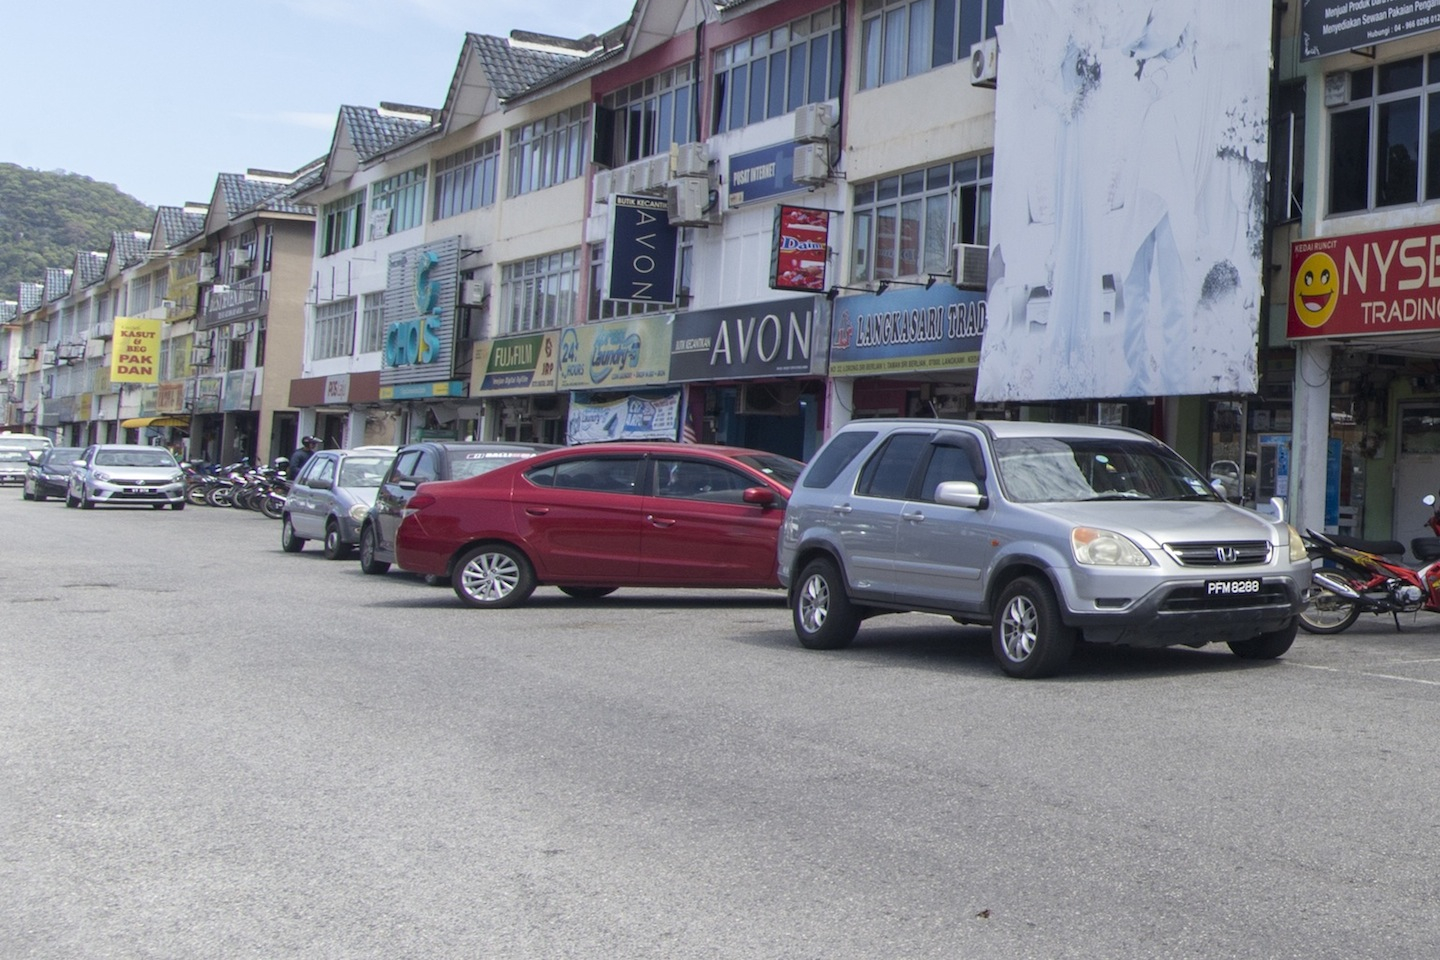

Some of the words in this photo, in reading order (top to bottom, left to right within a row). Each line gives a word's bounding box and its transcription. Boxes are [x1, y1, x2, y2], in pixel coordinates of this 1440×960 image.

[1325, 3, 1348, 19] Menjual
[1322, 17, 1361, 36] Menyediakan
[1362, 11, 1387, 26] Sewaan
[1388, 3, 1413, 19] Pakaian
[1367, 26, 1391, 40] Hubungi
[733, 169, 750, 186] PUSAT
[750, 162, 776, 183] INTERNET
[617, 197, 635, 205] BUTIK
[781, 235, 826, 250] Daim
[1295, 242, 1314, 253] KEDAI
[1314, 240, 1337, 249] RUNCIT
[631, 209, 656, 299] AVON
[856, 305, 945, 347] LANGKASARI
[121, 331, 156, 339] KASUT
[710, 311, 812, 365] AVON
[119, 354, 152, 364] PAK
[562, 343, 575, 363] 24
[591, 345, 629, 370] Laundry
[117, 366, 152, 375] DAN
[1208, 582, 1230, 594] PFM
[1231, 580, 1259, 593] 8288
